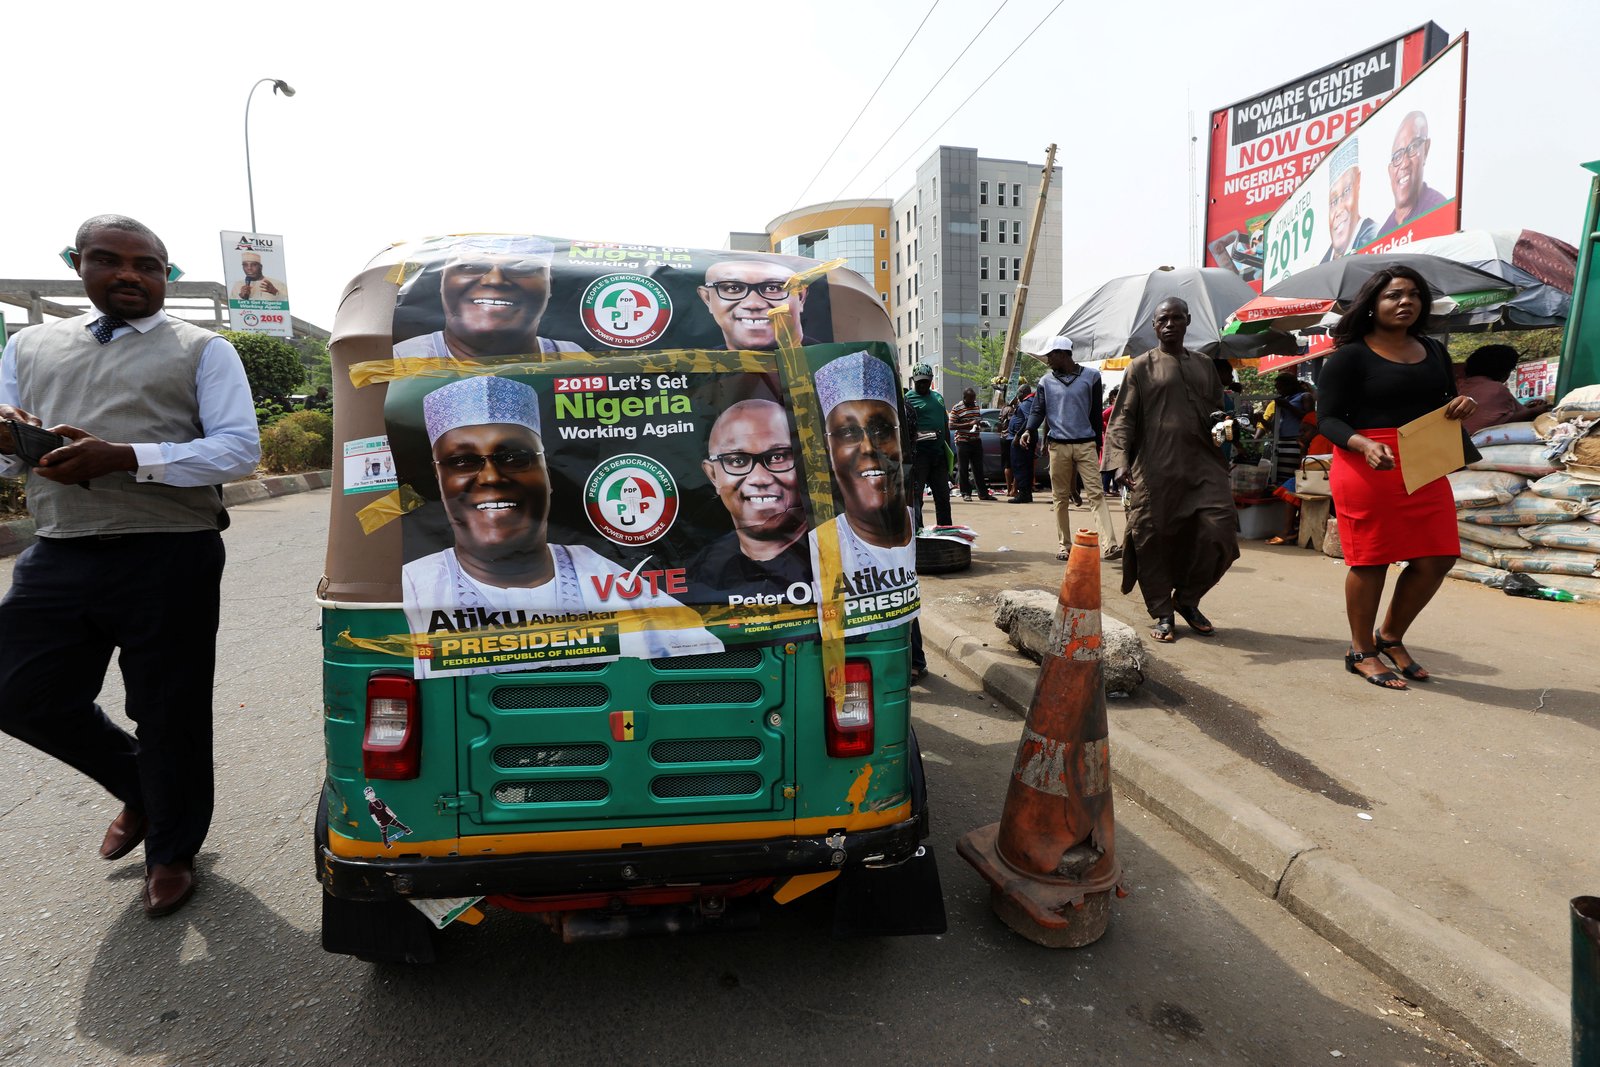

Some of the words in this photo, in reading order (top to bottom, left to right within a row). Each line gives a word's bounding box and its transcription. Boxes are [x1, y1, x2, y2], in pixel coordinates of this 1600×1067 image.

[1237, 86, 1305, 125] NOVARE
[1307, 52, 1391, 98] CENTRAL
[1256, 104, 1306, 134] MALL,
[1309, 80, 1363, 114] WUSE
[1239, 127, 1301, 168] NOW
[1223, 160, 1297, 196] NIGERIA'S
[1269, 208, 1315, 280] 2019
[1371, 229, 1414, 254] Ticket
[567, 259, 639, 269] Working
[568, 246, 692, 262] Nigeria
[586, 278, 610, 305] PEOPLE'S
[611, 275, 655, 288] DEMOCRATIC
[653, 285, 668, 305] PARTY
[260, 314, 284, 324] 2019
[1247, 309, 1265, 319] PDP
[1266, 301, 1323, 316] VOLUNTEERS
[636, 330, 657, 343] PEOPLE
[557, 377, 604, 391] 2019
[607, 375, 652, 391] Let's
[656, 374, 688, 389] Get
[554, 389, 692, 425] Nigeria
[558, 425, 637, 440] Working
[642, 420, 694, 438] Again
[589, 466, 610, 498] PEOPLE'S
[609, 458, 656, 472] DEMOCRATIC
[656, 470, 673, 493] PARTY
[634, 533, 646, 541] THE
[645, 522, 665, 539] PEOPLE
[590, 568, 689, 601] VOTE
[831, 566, 908, 600] Atiku
[728, 593, 785, 609] Peter
[427, 607, 528, 635] Atiku
[529, 610, 618, 626] Abubakar
[824, 609, 837, 618] as
[847, 613, 883, 625] FEDERAL
[885, 604, 915, 618] REPUBLIC
[744, 626, 772, 634] FEDERAL
[773, 621, 801, 630] REPUBLIC
[418, 646, 432, 656] as
[441, 627, 605, 657] PRESIDENT
[442, 656, 490, 666] FEDERAL
[493, 651, 545, 662] REPUBLIC
[548, 649, 563, 658] OF
[565, 646, 607, 656] NIGERIA
